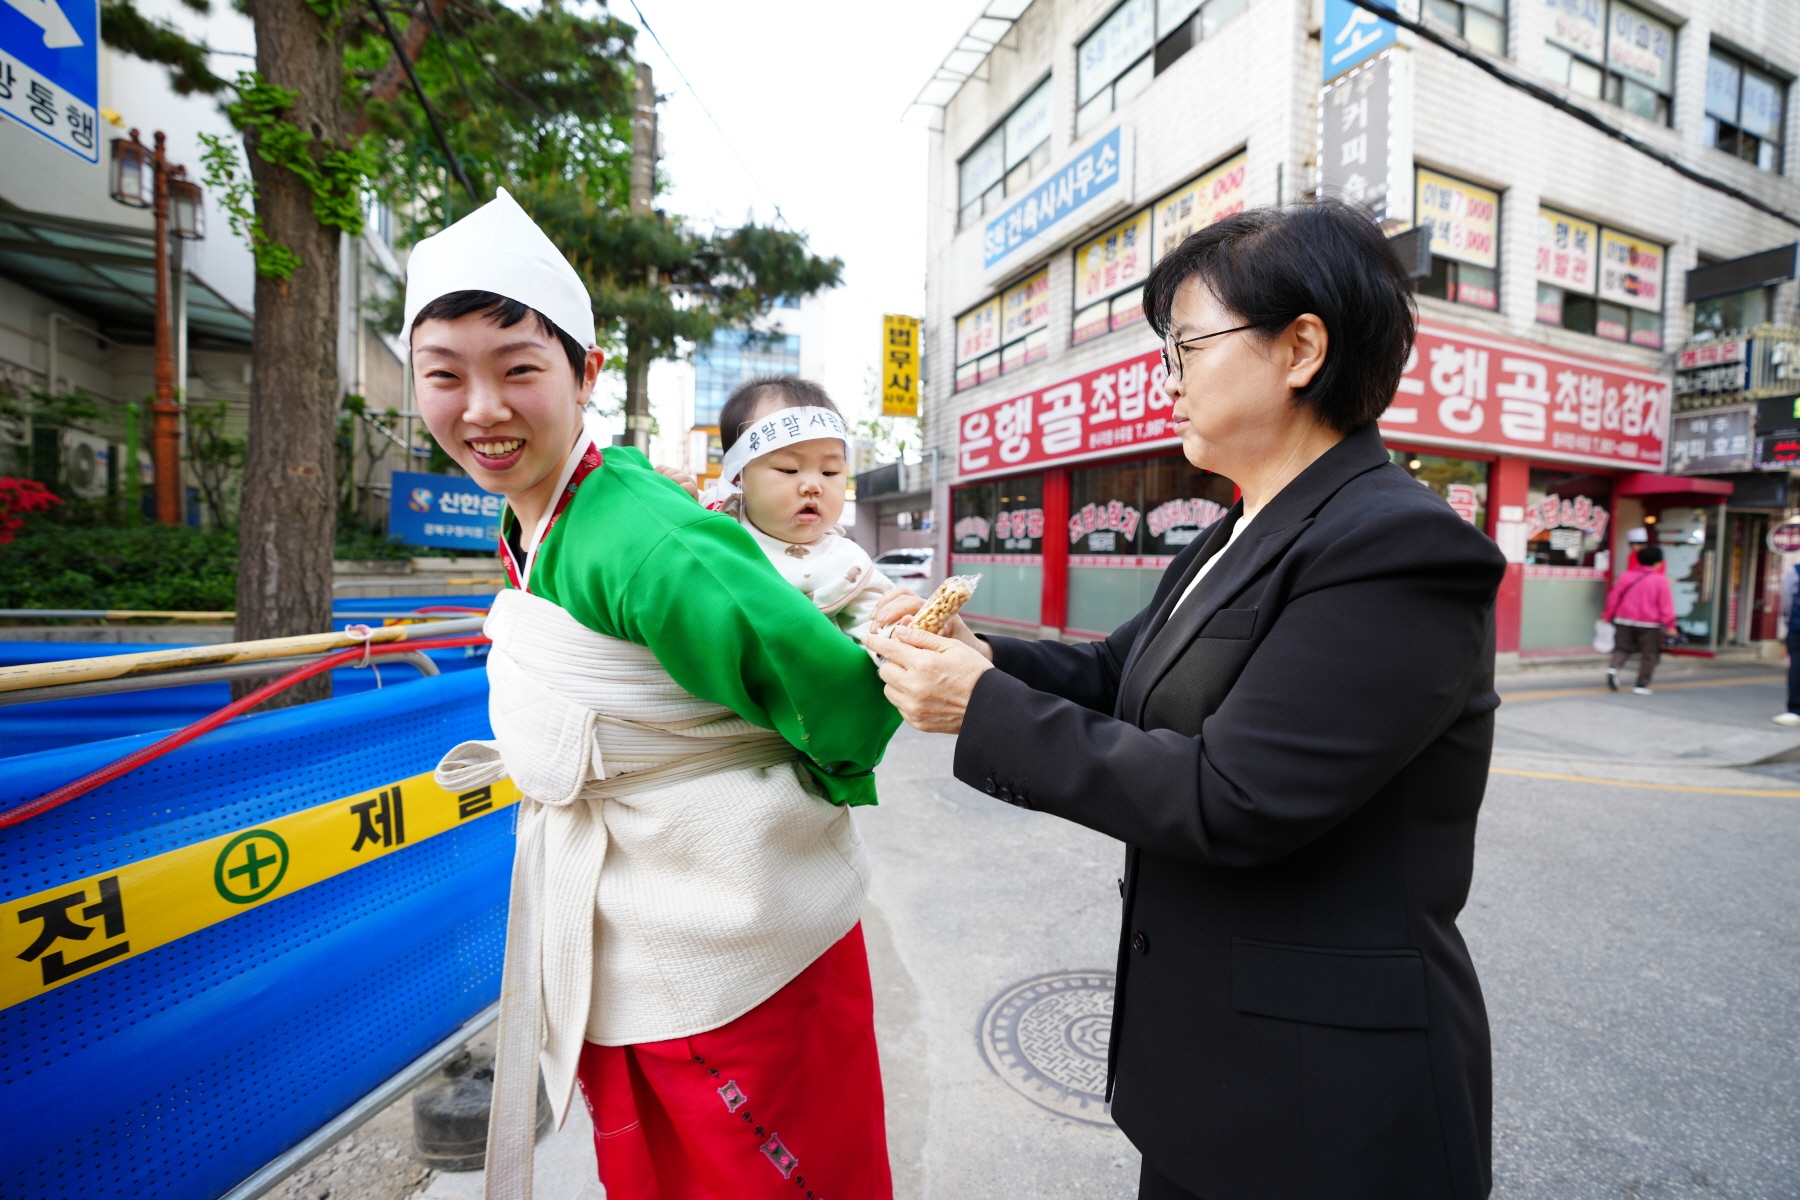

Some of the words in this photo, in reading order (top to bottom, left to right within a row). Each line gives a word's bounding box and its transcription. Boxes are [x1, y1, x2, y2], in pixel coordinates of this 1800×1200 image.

[1424, 183, 1452, 211] 이발
[889, 327, 912, 393] 법무사
[960, 382, 1086, 471] 은행골
[1553, 368, 1664, 441] 초밥&참치
[438, 491, 506, 517] 신한은
